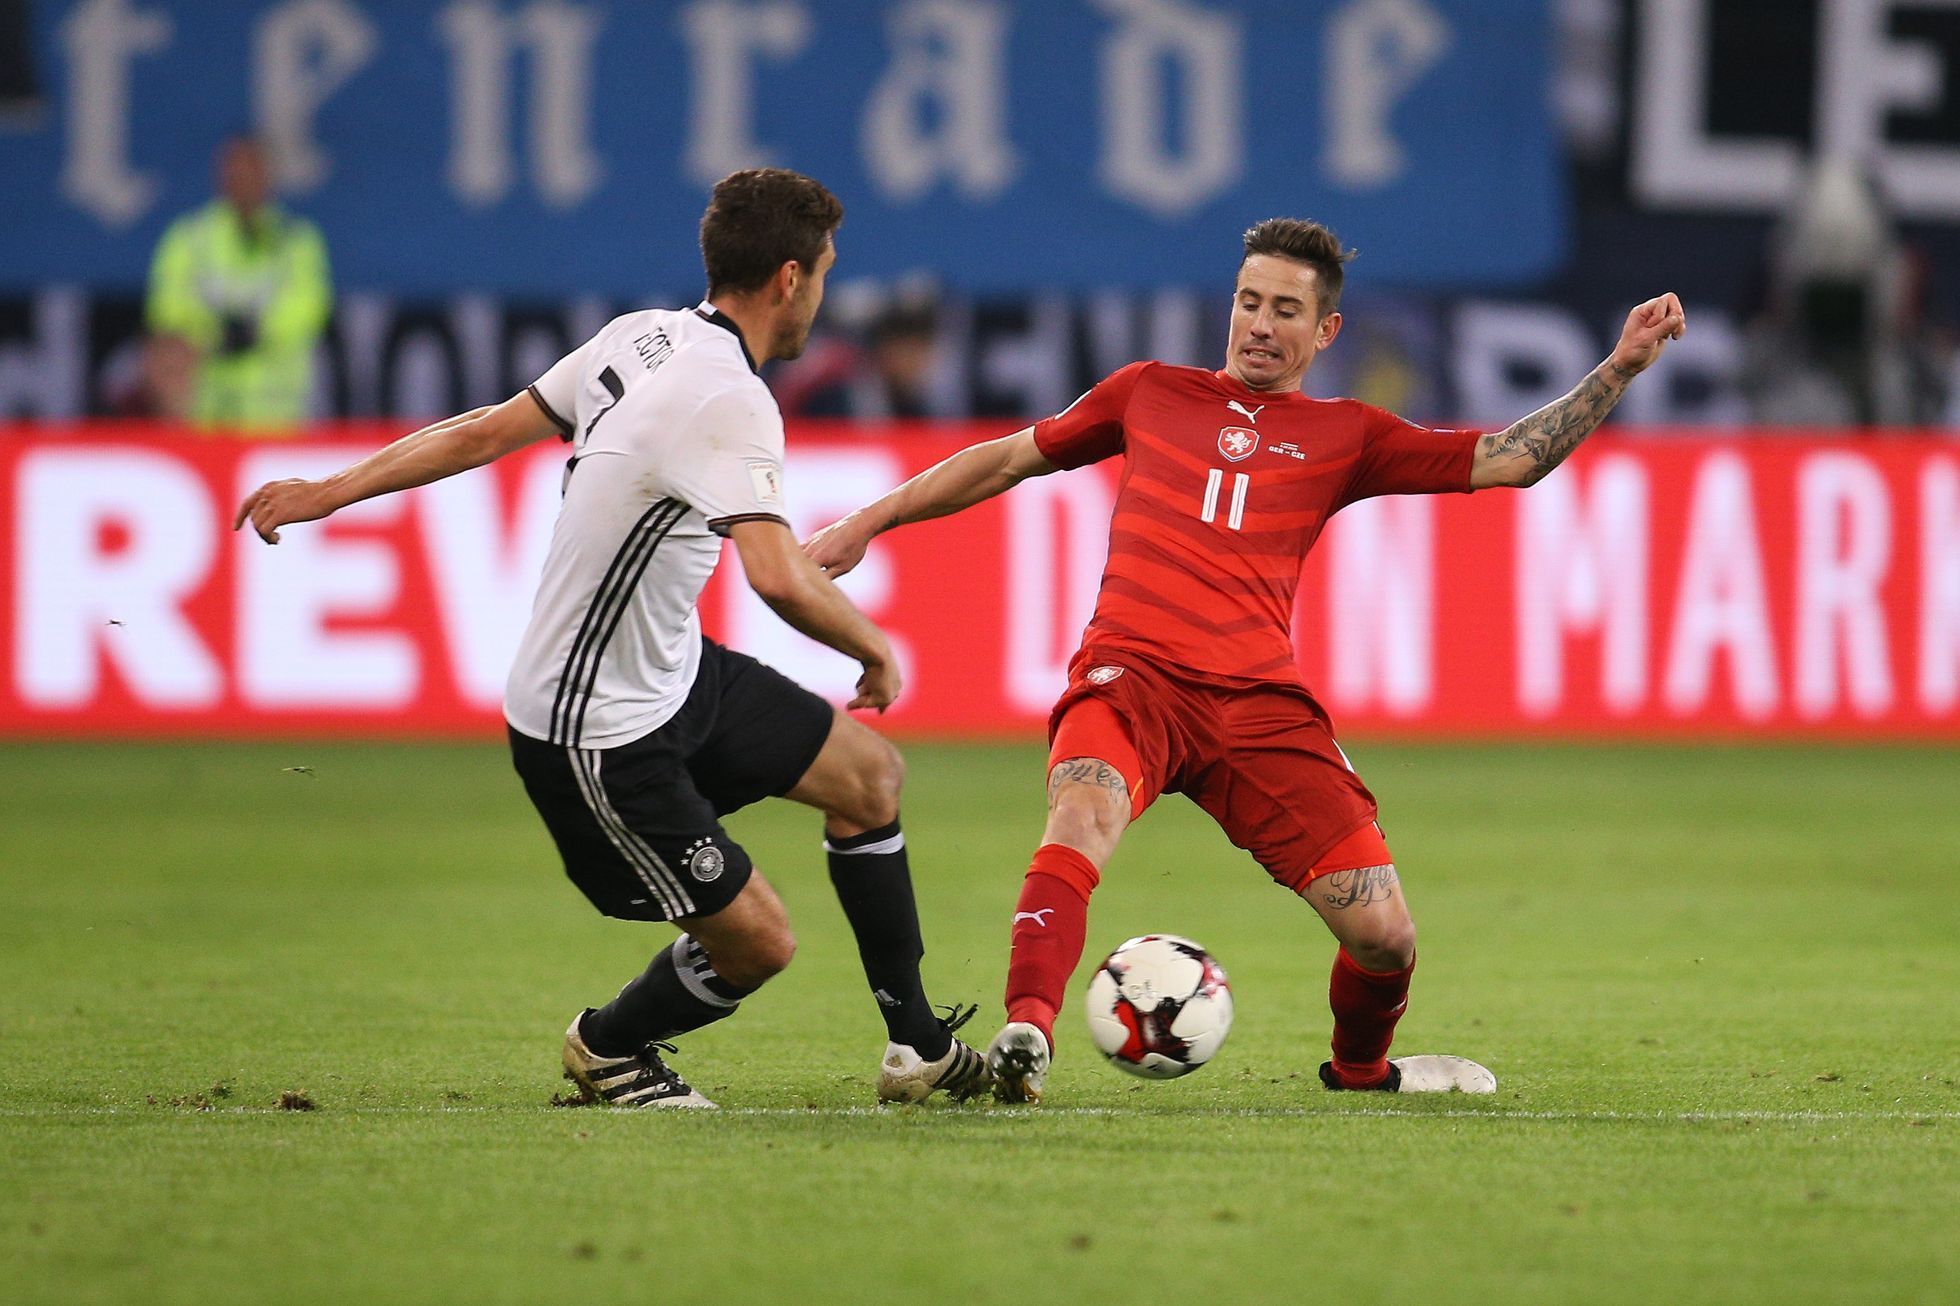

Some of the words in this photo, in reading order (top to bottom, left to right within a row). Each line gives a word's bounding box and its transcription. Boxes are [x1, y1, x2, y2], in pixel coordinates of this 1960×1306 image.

[1268, 445, 1284, 454] GER
[1291, 451, 1306, 460] CZE
[1201, 468, 1250, 531] 11
[1006, 458, 1435, 718] DN
